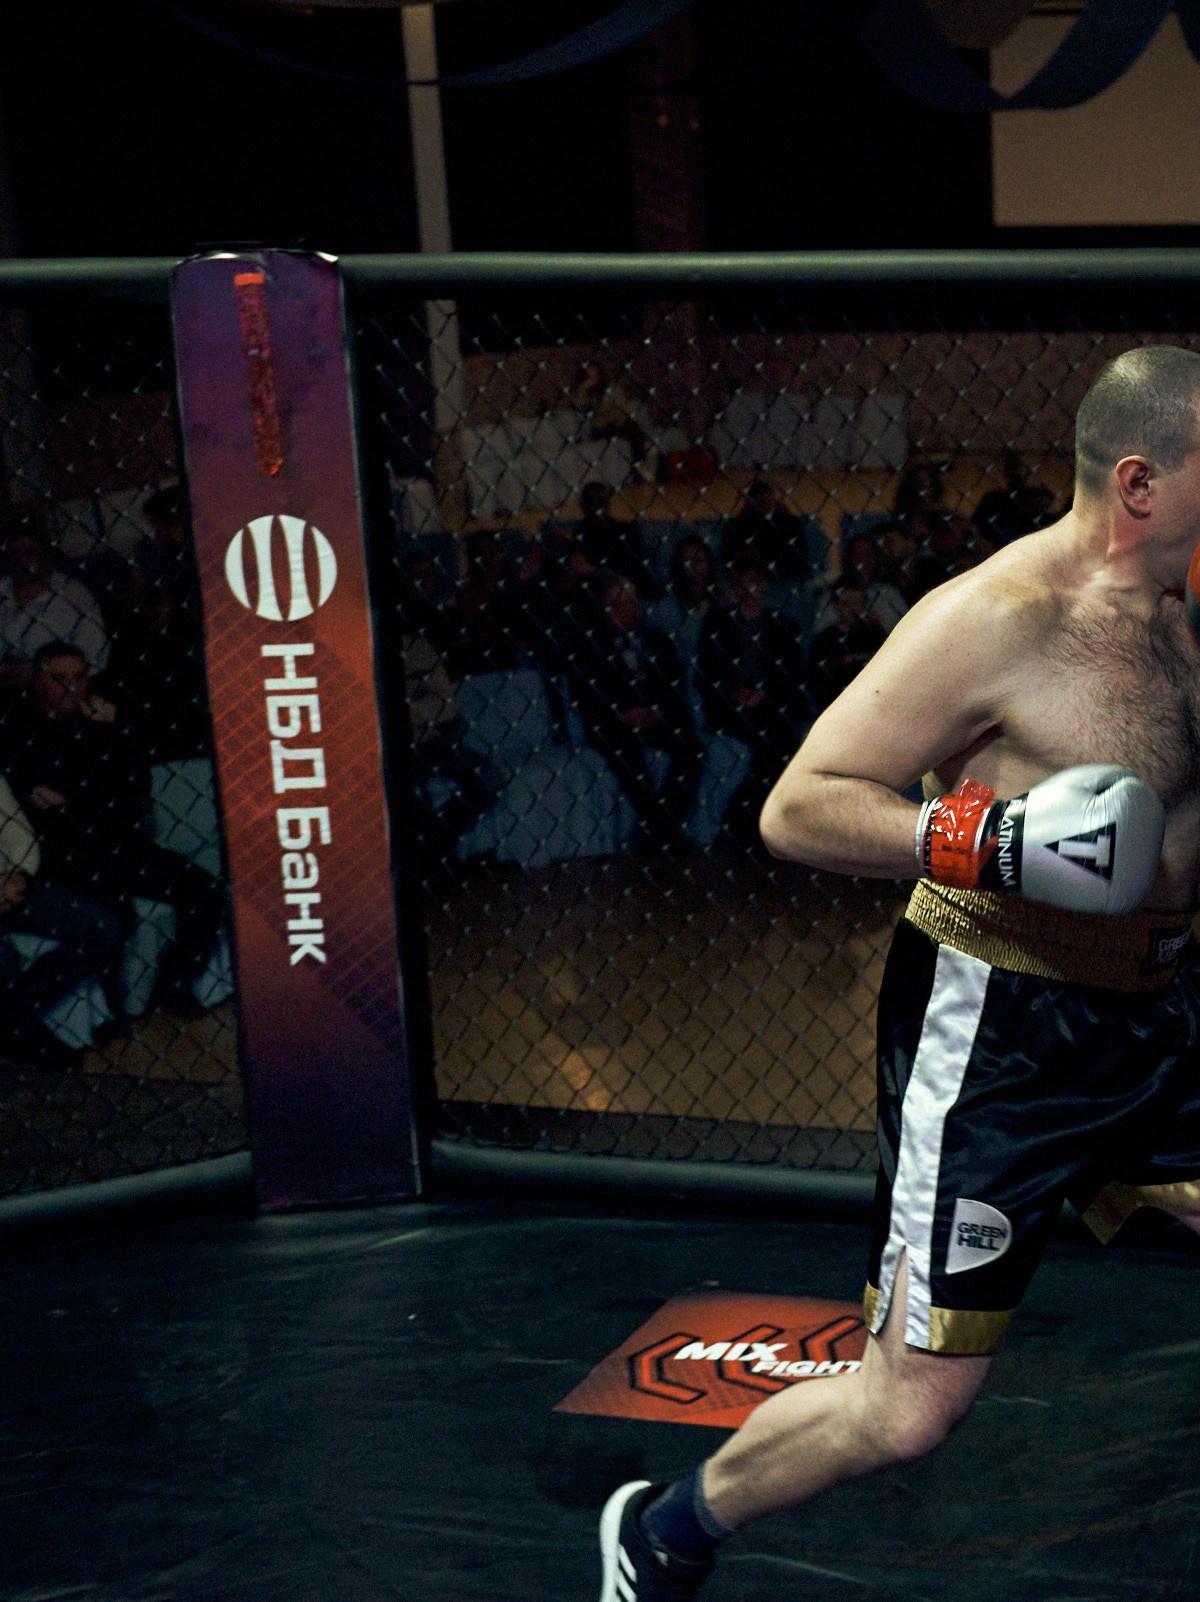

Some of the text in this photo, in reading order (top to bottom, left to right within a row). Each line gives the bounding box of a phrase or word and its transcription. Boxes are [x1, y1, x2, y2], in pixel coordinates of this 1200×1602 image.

[261, 643, 331, 966] НБД Банк
[998, 800, 1017, 887] ATINUM
[957, 1233, 1001, 1251] HILL
[958, 1222, 1007, 1239] GREEN
[673, 1342, 862, 1376] MIX FIGHT
